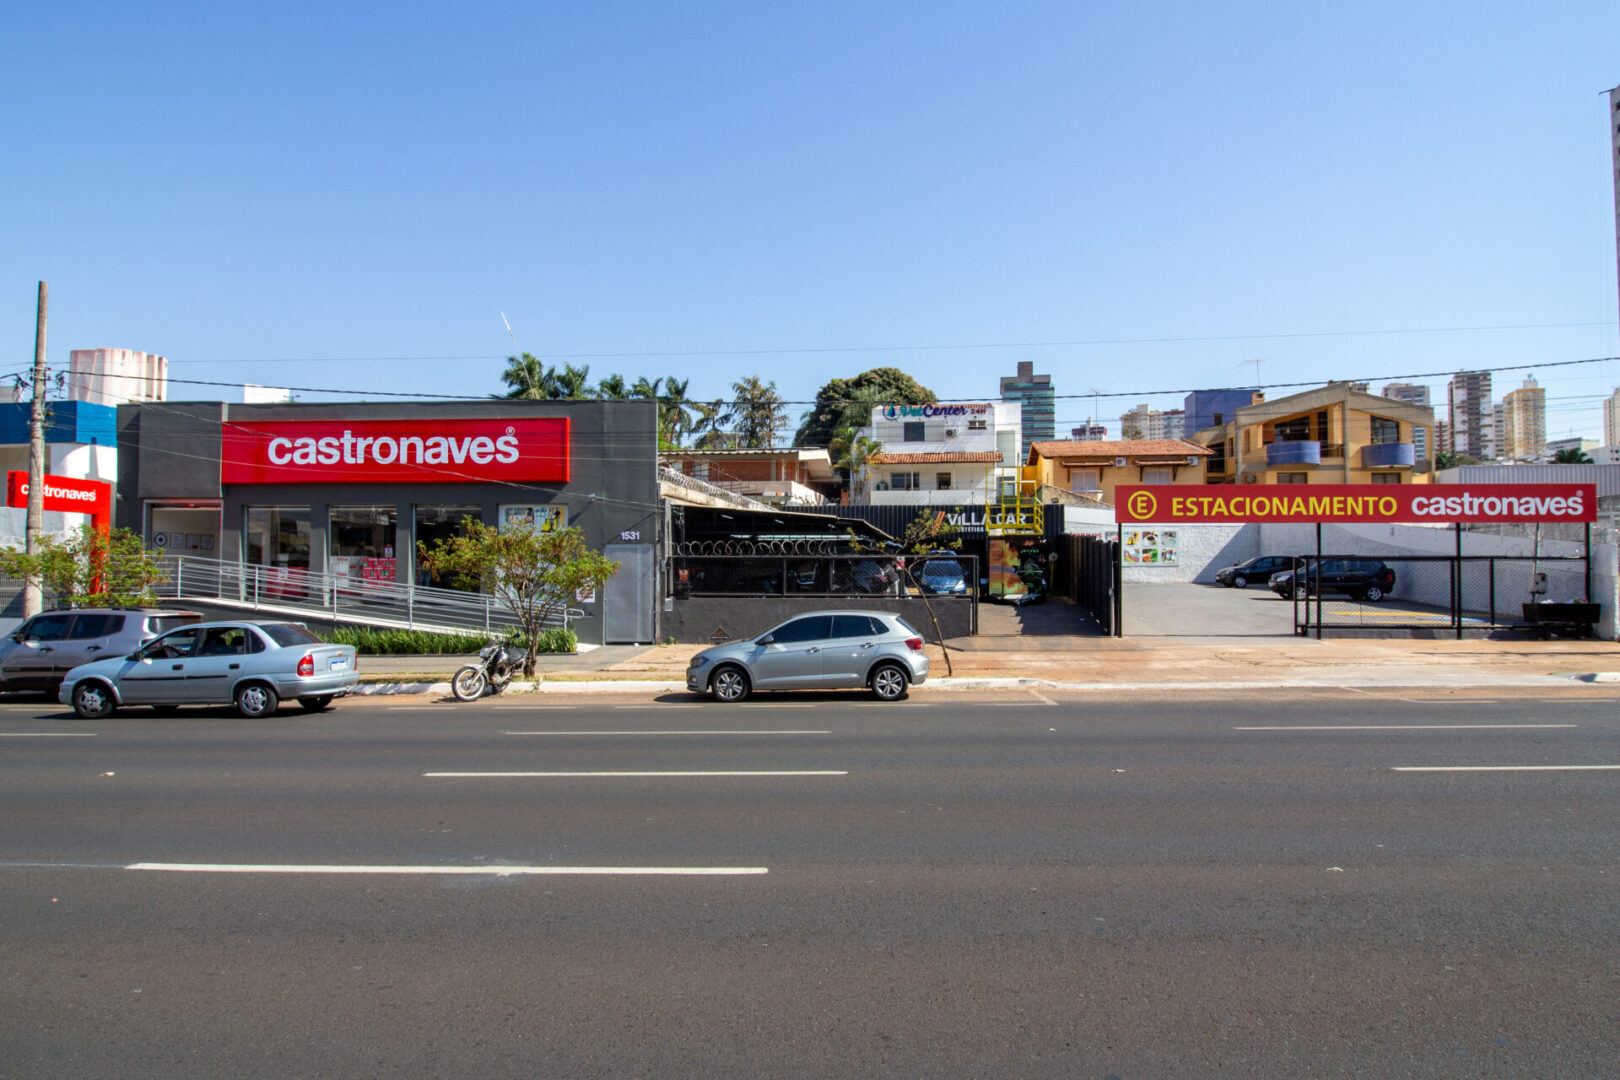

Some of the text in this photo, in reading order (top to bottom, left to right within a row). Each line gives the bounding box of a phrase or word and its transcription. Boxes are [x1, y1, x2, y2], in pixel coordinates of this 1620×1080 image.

[21, 484, 97, 502] ctronaves
[1172, 496, 1398, 517] ESTACIONAMENTO
[620, 531, 640, 541] 1531
